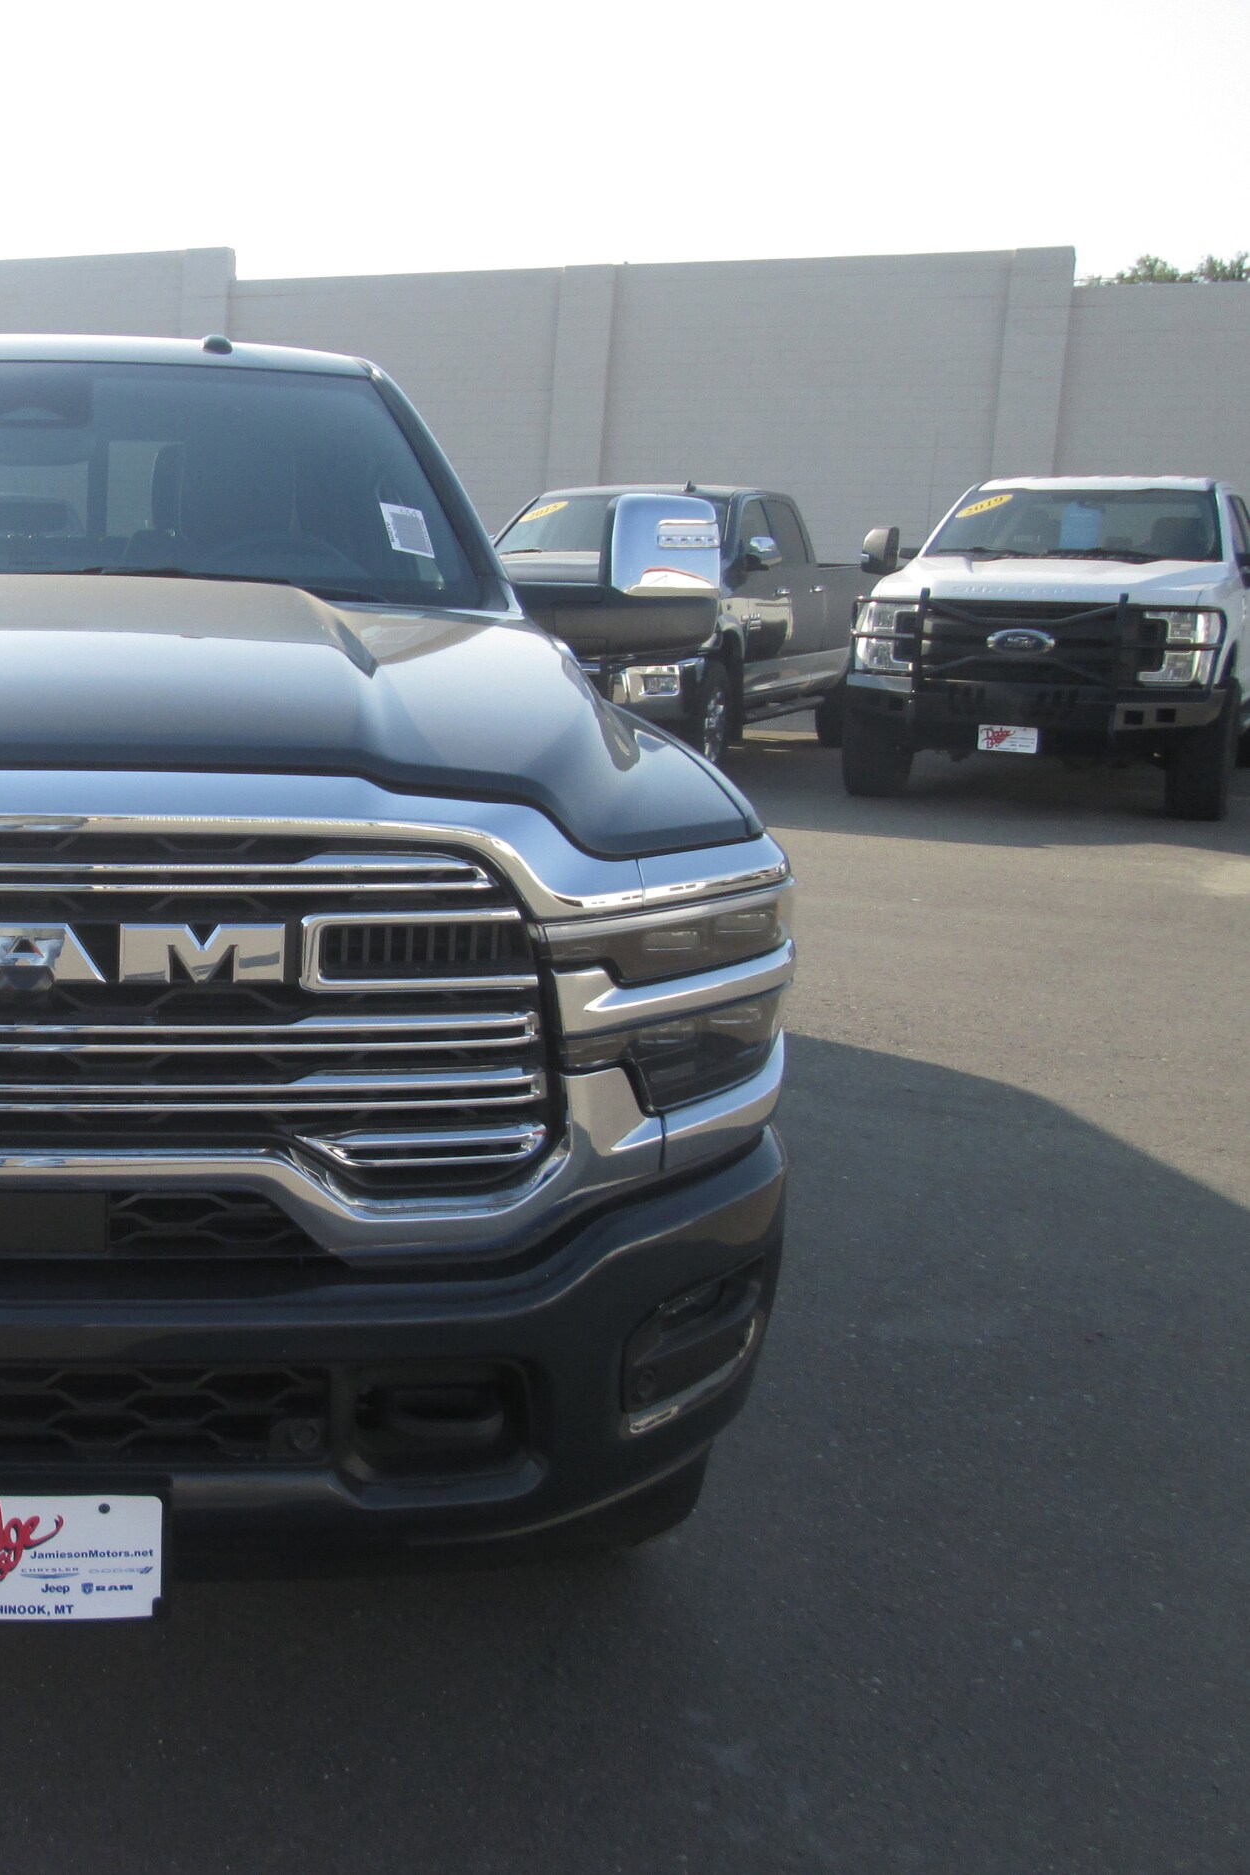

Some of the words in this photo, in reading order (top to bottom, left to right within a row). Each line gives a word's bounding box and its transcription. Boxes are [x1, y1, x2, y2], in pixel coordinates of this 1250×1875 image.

[965, 497, 1004, 515] 2019
[30, 1549, 154, 1560] JamiesonMotors.net
[41, 1583, 70, 1595] Jeep
[95, 1584, 134, 1592] RAM
[54, 1604, 75, 1616] MT
